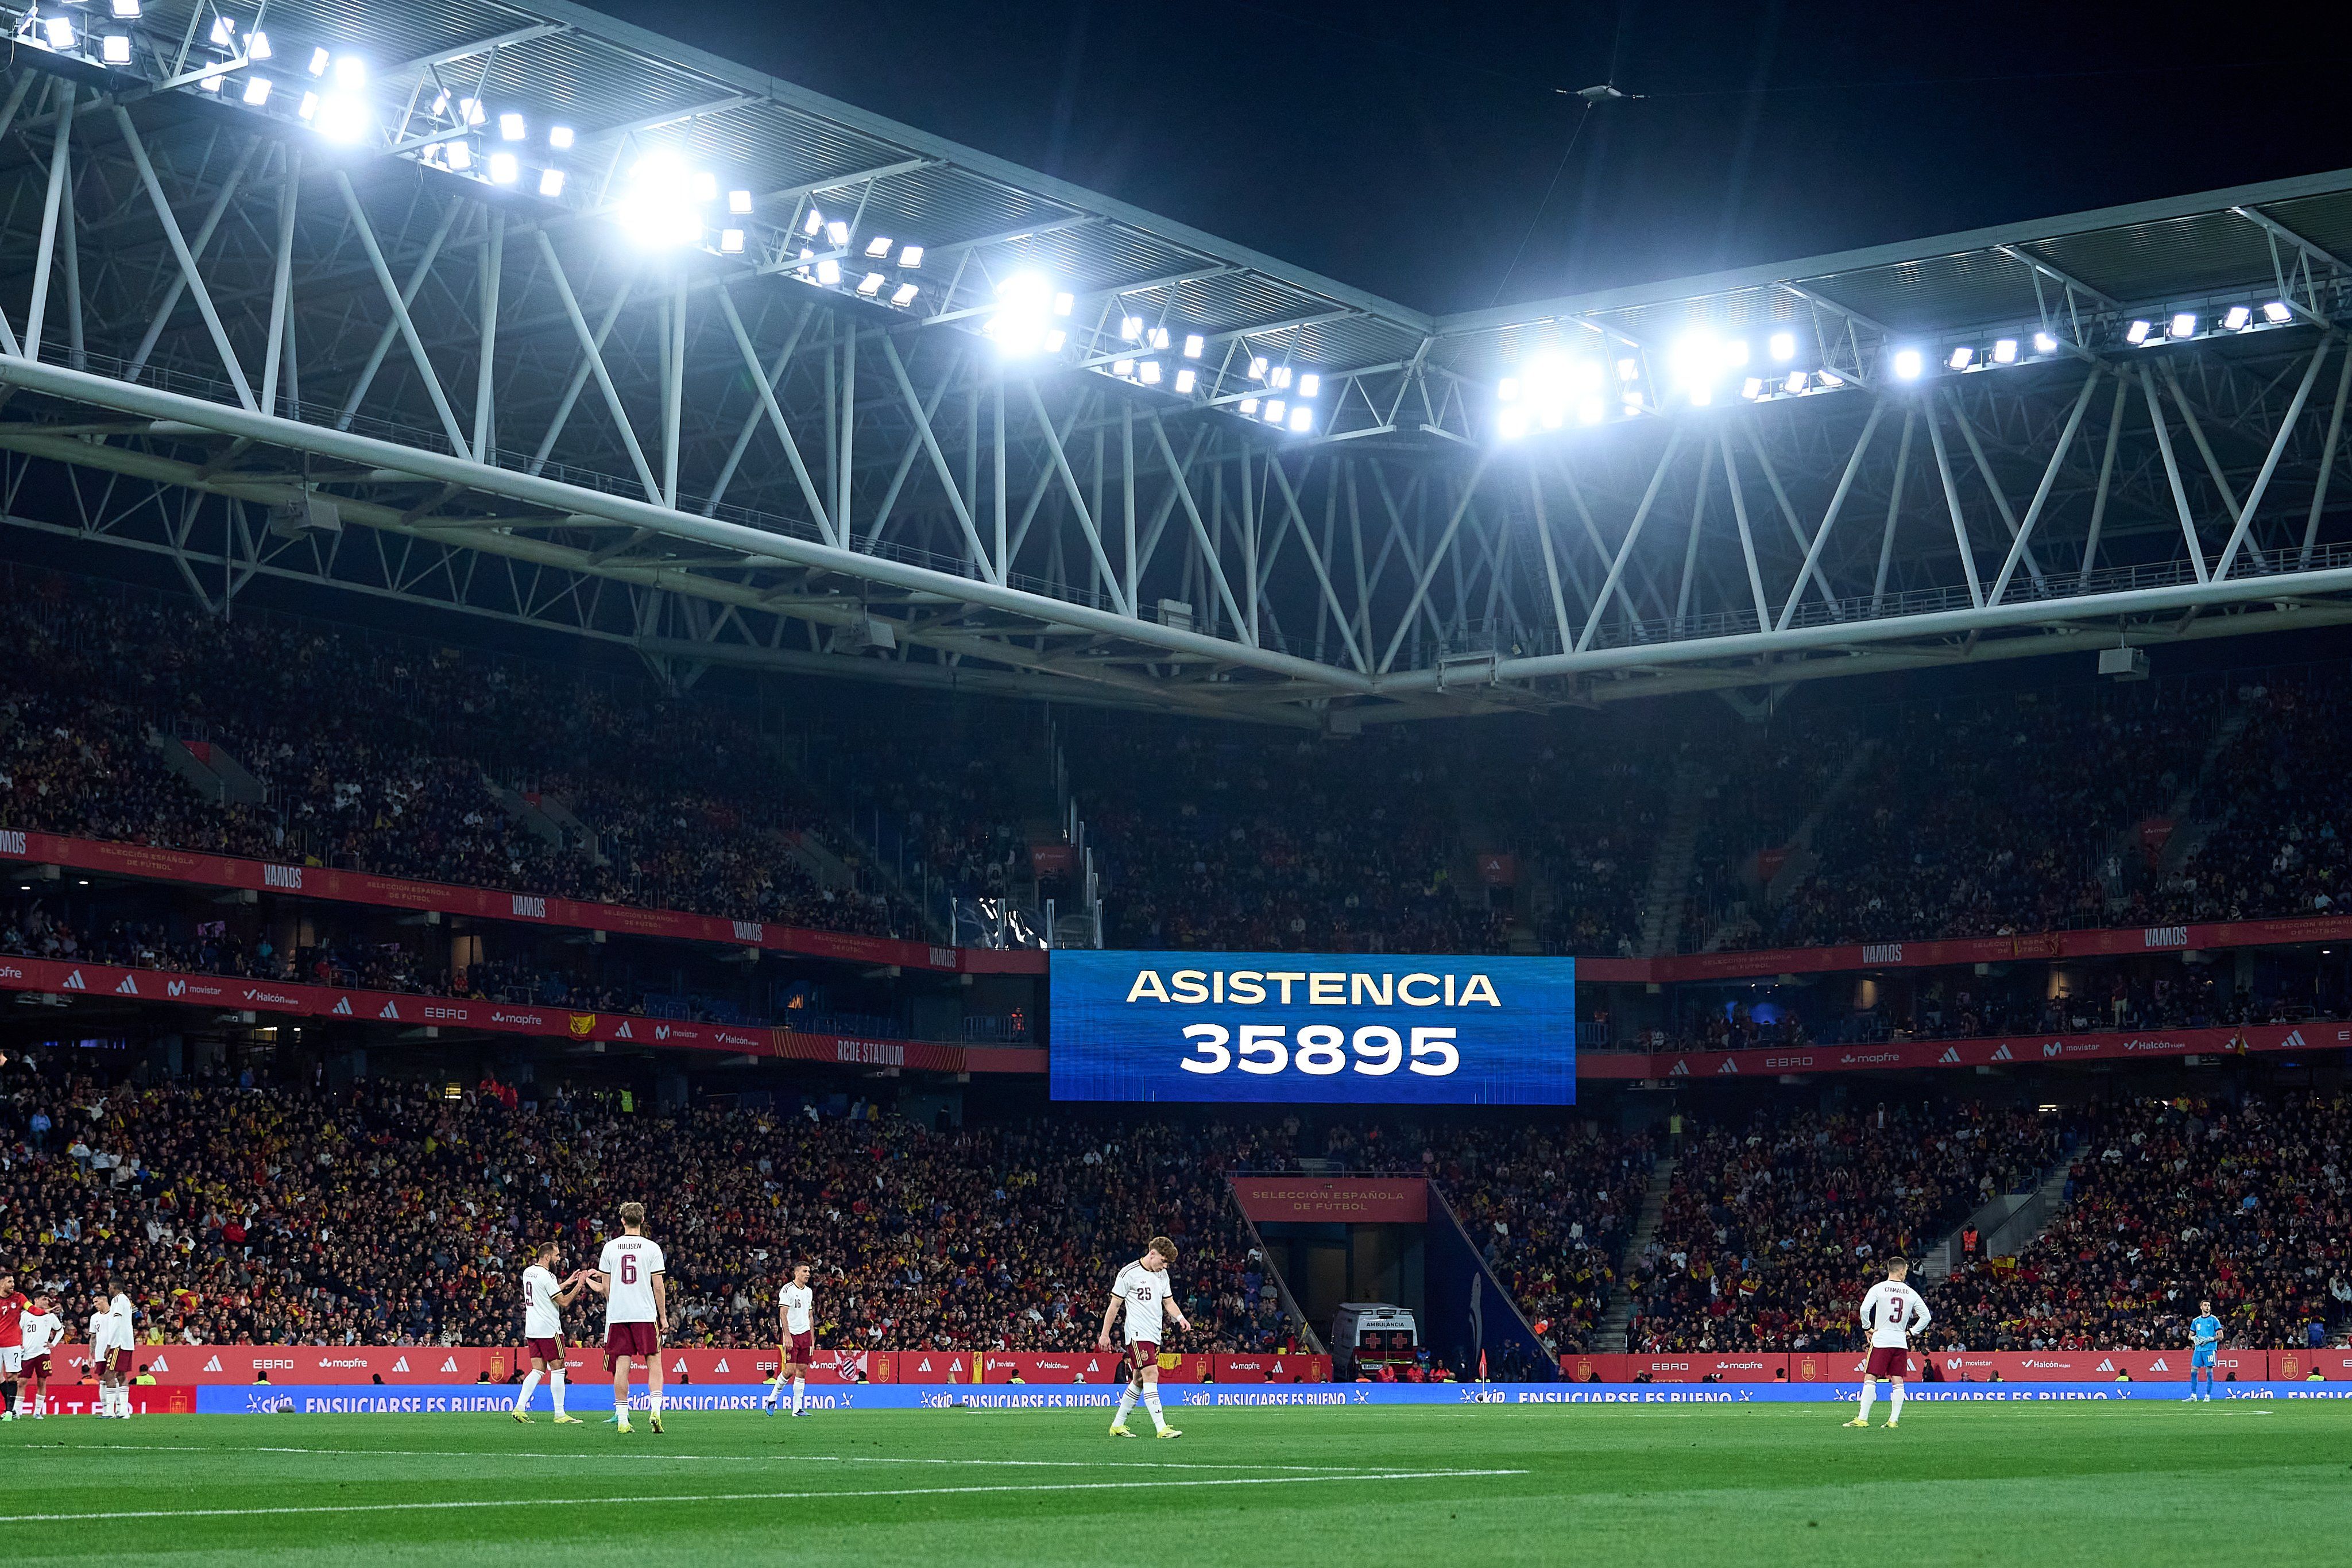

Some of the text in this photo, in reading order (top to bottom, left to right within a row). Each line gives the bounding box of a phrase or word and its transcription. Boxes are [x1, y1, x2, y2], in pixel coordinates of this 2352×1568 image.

[0, 830, 26, 854] MOS
[264, 864, 301, 889] VAMOS
[512, 895, 546, 918] VAMOS
[733, 920, 763, 943] VAMOS
[2145, 927, 2187, 947] VAMOS
[929, 947, 956, 969] VAMOS
[1863, 944, 1902, 964] VAMOS
[189, 984, 222, 995] movistar
[1126, 970, 1502, 1006] ASISTENCIA
[257, 992, 285, 1004] Halcón
[425, 1008, 467, 1020] EBRO
[506, 1013, 541, 1026] mapfre
[672, 1029, 698, 1039] movistar
[725, 1035, 748, 1045] Halcón
[1180, 1024, 1459, 1076] 35895
[2067, 1043, 2100, 1051] movistar
[2139, 1040, 2169, 1050] Halcón
[838, 1040, 904, 1066] RCDE STADIUM
[1858, 1052, 1900, 1064] mapfre
[1766, 1057, 1813, 1067] EBRO
[1253, 1190, 1404, 1199] SELECCIÓN ESPAÑOLA
[1316, 1202, 1367, 1210] FÚTBOL
[621, 1254, 636, 1284] 6
[526, 1281, 533, 1306] 9
[1137, 1287, 1151, 1300] 25
[794, 1299, 801, 1308] 16
[2, 1306, 7, 1315] 7
[1889, 1297, 1904, 1323] 3
[27, 1324, 36, 1333] 20
[14, 1353, 18, 1363] 7
[333, 1358, 368, 1369] mapfre
[2034, 1360, 2058, 1368] Halcón
[42, 1360, 52, 1370] 20
[253, 1360, 293, 1369] EBRO
[1239, 1362, 1260, 1370] mapfre
[1730, 1361, 1763, 1370] mapfre
[305, 1397, 420, 1413] ENSUCIARSE
[427, 1397, 446, 1413] ES
[451, 1396, 513, 1412] BUENO
[783, 1395, 835, 1410] BENO
[1048, 1394, 1062, 1407] ES
[1066, 1394, 1111, 1407] BUENO
[1218, 1393, 1287, 1406] ENSUCIARSE
[1291, 1393, 1303, 1406] ES
[1307, 1393, 1346, 1405] BUENO
